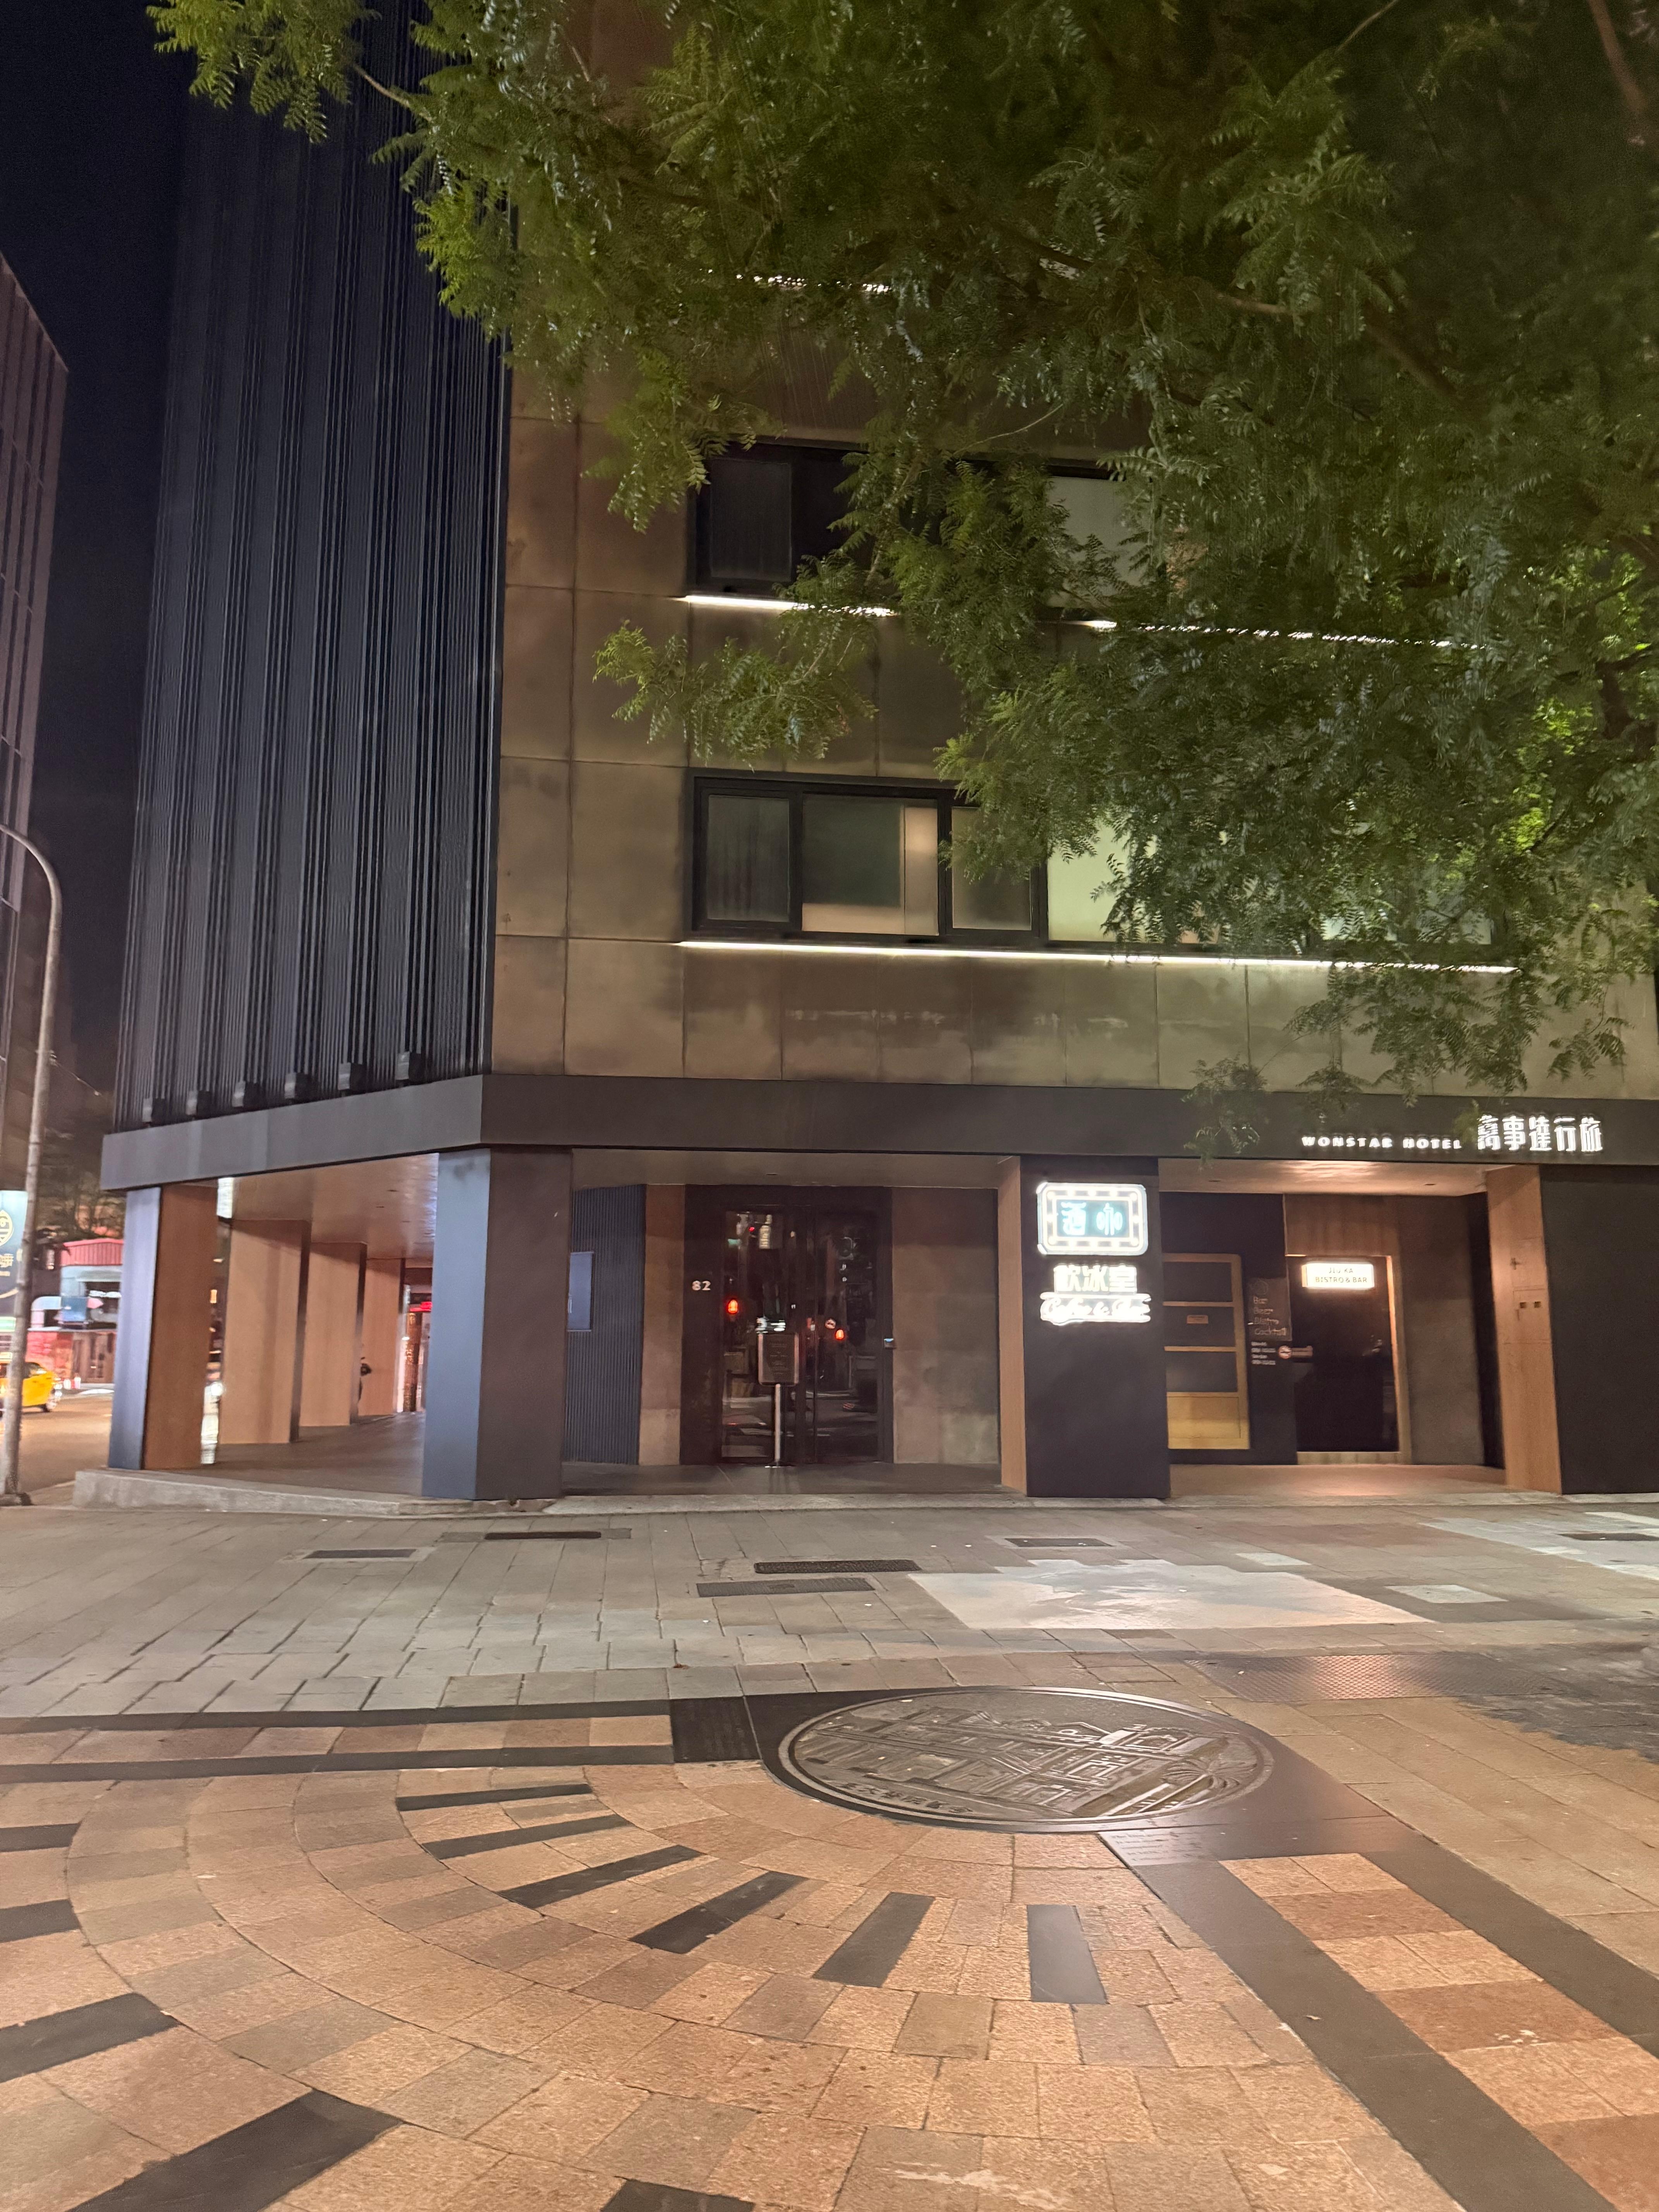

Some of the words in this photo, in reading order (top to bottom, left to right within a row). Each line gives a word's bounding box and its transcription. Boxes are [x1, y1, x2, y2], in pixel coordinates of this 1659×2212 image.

[1302, 1137, 1392, 1148] WONSTAR
[1403, 1138, 1462, 1149] HOTEL
[692, 1280, 711, 1290] 82
